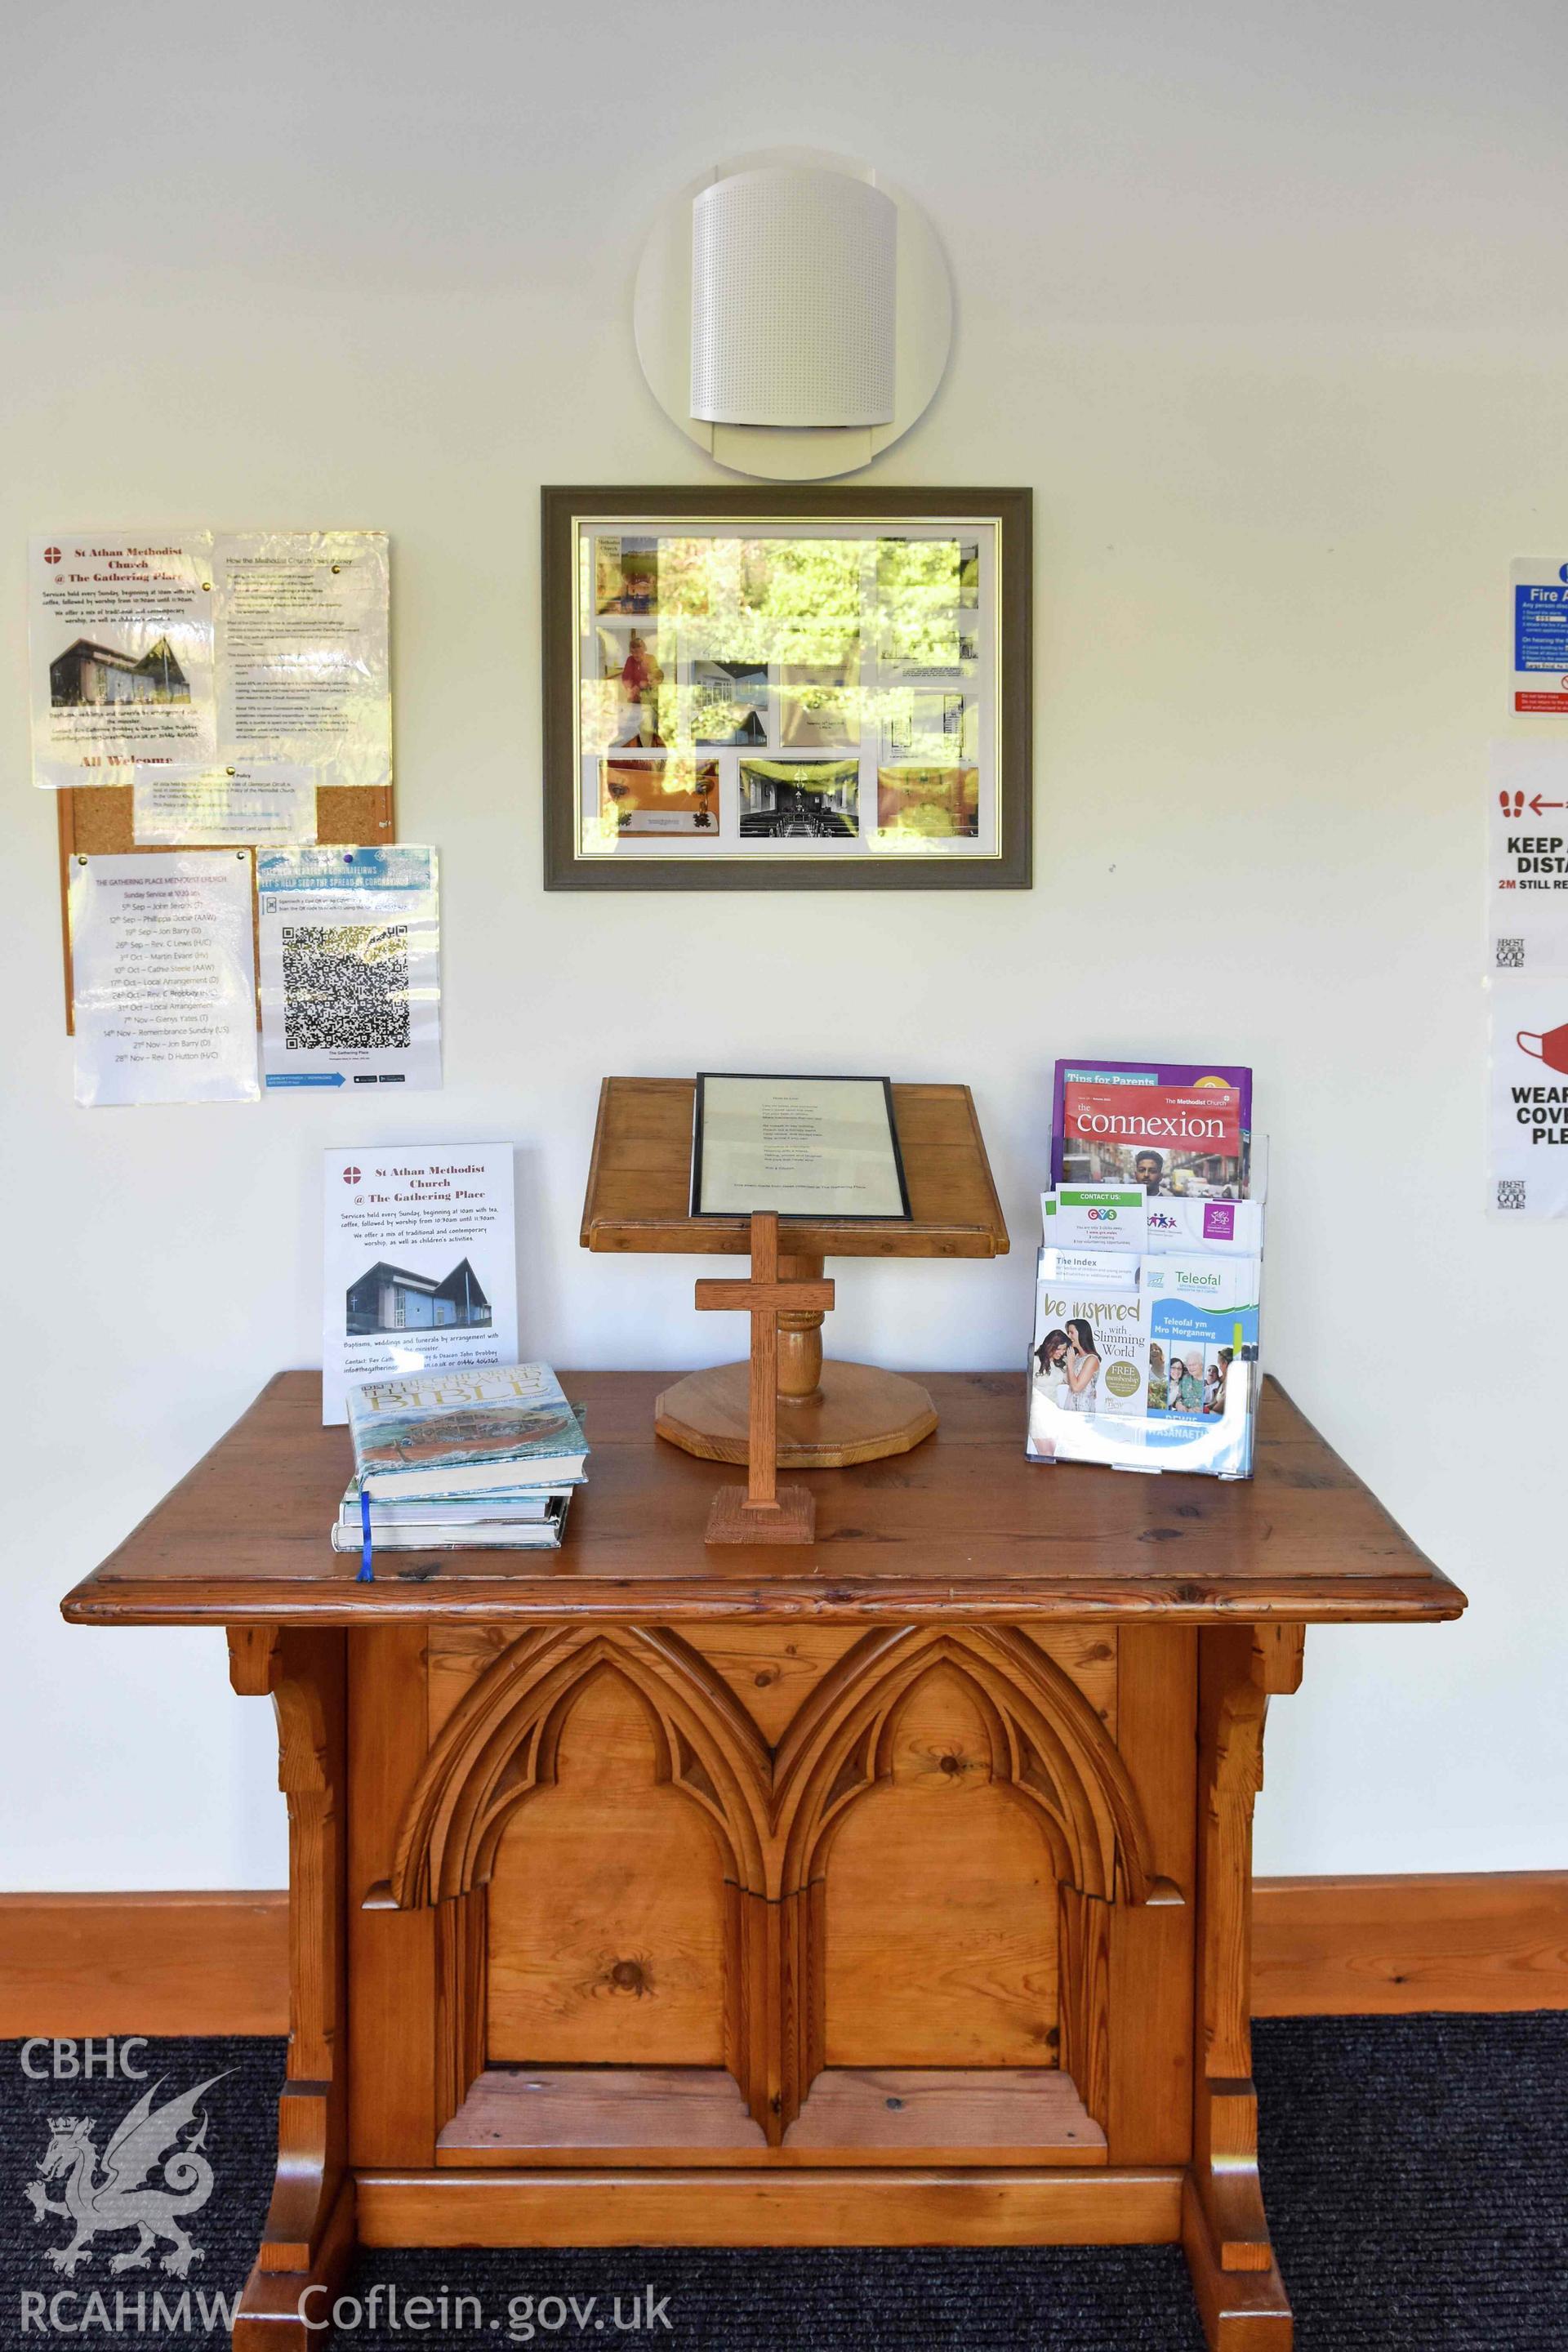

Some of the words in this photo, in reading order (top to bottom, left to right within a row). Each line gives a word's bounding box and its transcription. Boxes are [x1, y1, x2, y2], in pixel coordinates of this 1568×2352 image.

[74, 549, 86, 557] St
[90, 549, 122, 557] Athan
[127, 547, 182, 556] Methodist
[108, 560, 149, 568] Church
[54, 574, 65, 585] @
[69, 574, 90, 582] The
[93, 572, 149, 583] Gathering
[1530, 589, 1558, 601] Fire
[1508, 837, 1563, 853] KEEP
[109, 878, 144, 886] GATHERING
[1499, 880, 1516, 889] 2M
[1519, 880, 1551, 889] STILL
[1094, 1076, 1111, 1085] for
[1113, 1077, 1154, 1085] Parents
[1078, 1103, 1090, 1111] the
[1077, 1111, 1226, 1138] connexion
[375, 1169, 386, 1177] St
[390, 1168, 425, 1177] Athan
[429, 1165, 485, 1174] Methodist
[410, 1178, 451, 1188] Church
[354, 1196, 365, 1205] @
[368, 1194, 390, 1203] The
[394, 1192, 451, 1203] Gathering
[455, 1191, 486, 1199] Place
[423, 1209, 451, 1218] beginning
[406, 1227, 434, 1236] traditional
[1175, 1272, 1221, 1285] Teleofal
[1045, 1293, 1067, 1316] be
[1072, 1298, 1141, 1327] inspired
[1164, 1317, 1192, 1326] Teleofal
[1109, 1325, 1127, 1334] with
[1155, 1325, 1169, 1334] Mro
[1172, 1327, 1216, 1339] Morgannwg
[450, 1334, 485, 1342] arrangement
[1094, 1330, 1145, 1348] Slimming
[1102, 1343, 1134, 1357] World
[1111, 1365, 1135, 1375] FREE
[1106, 1375, 1139, 1384] membership
[370, 1378, 549, 1411] BIBLE
